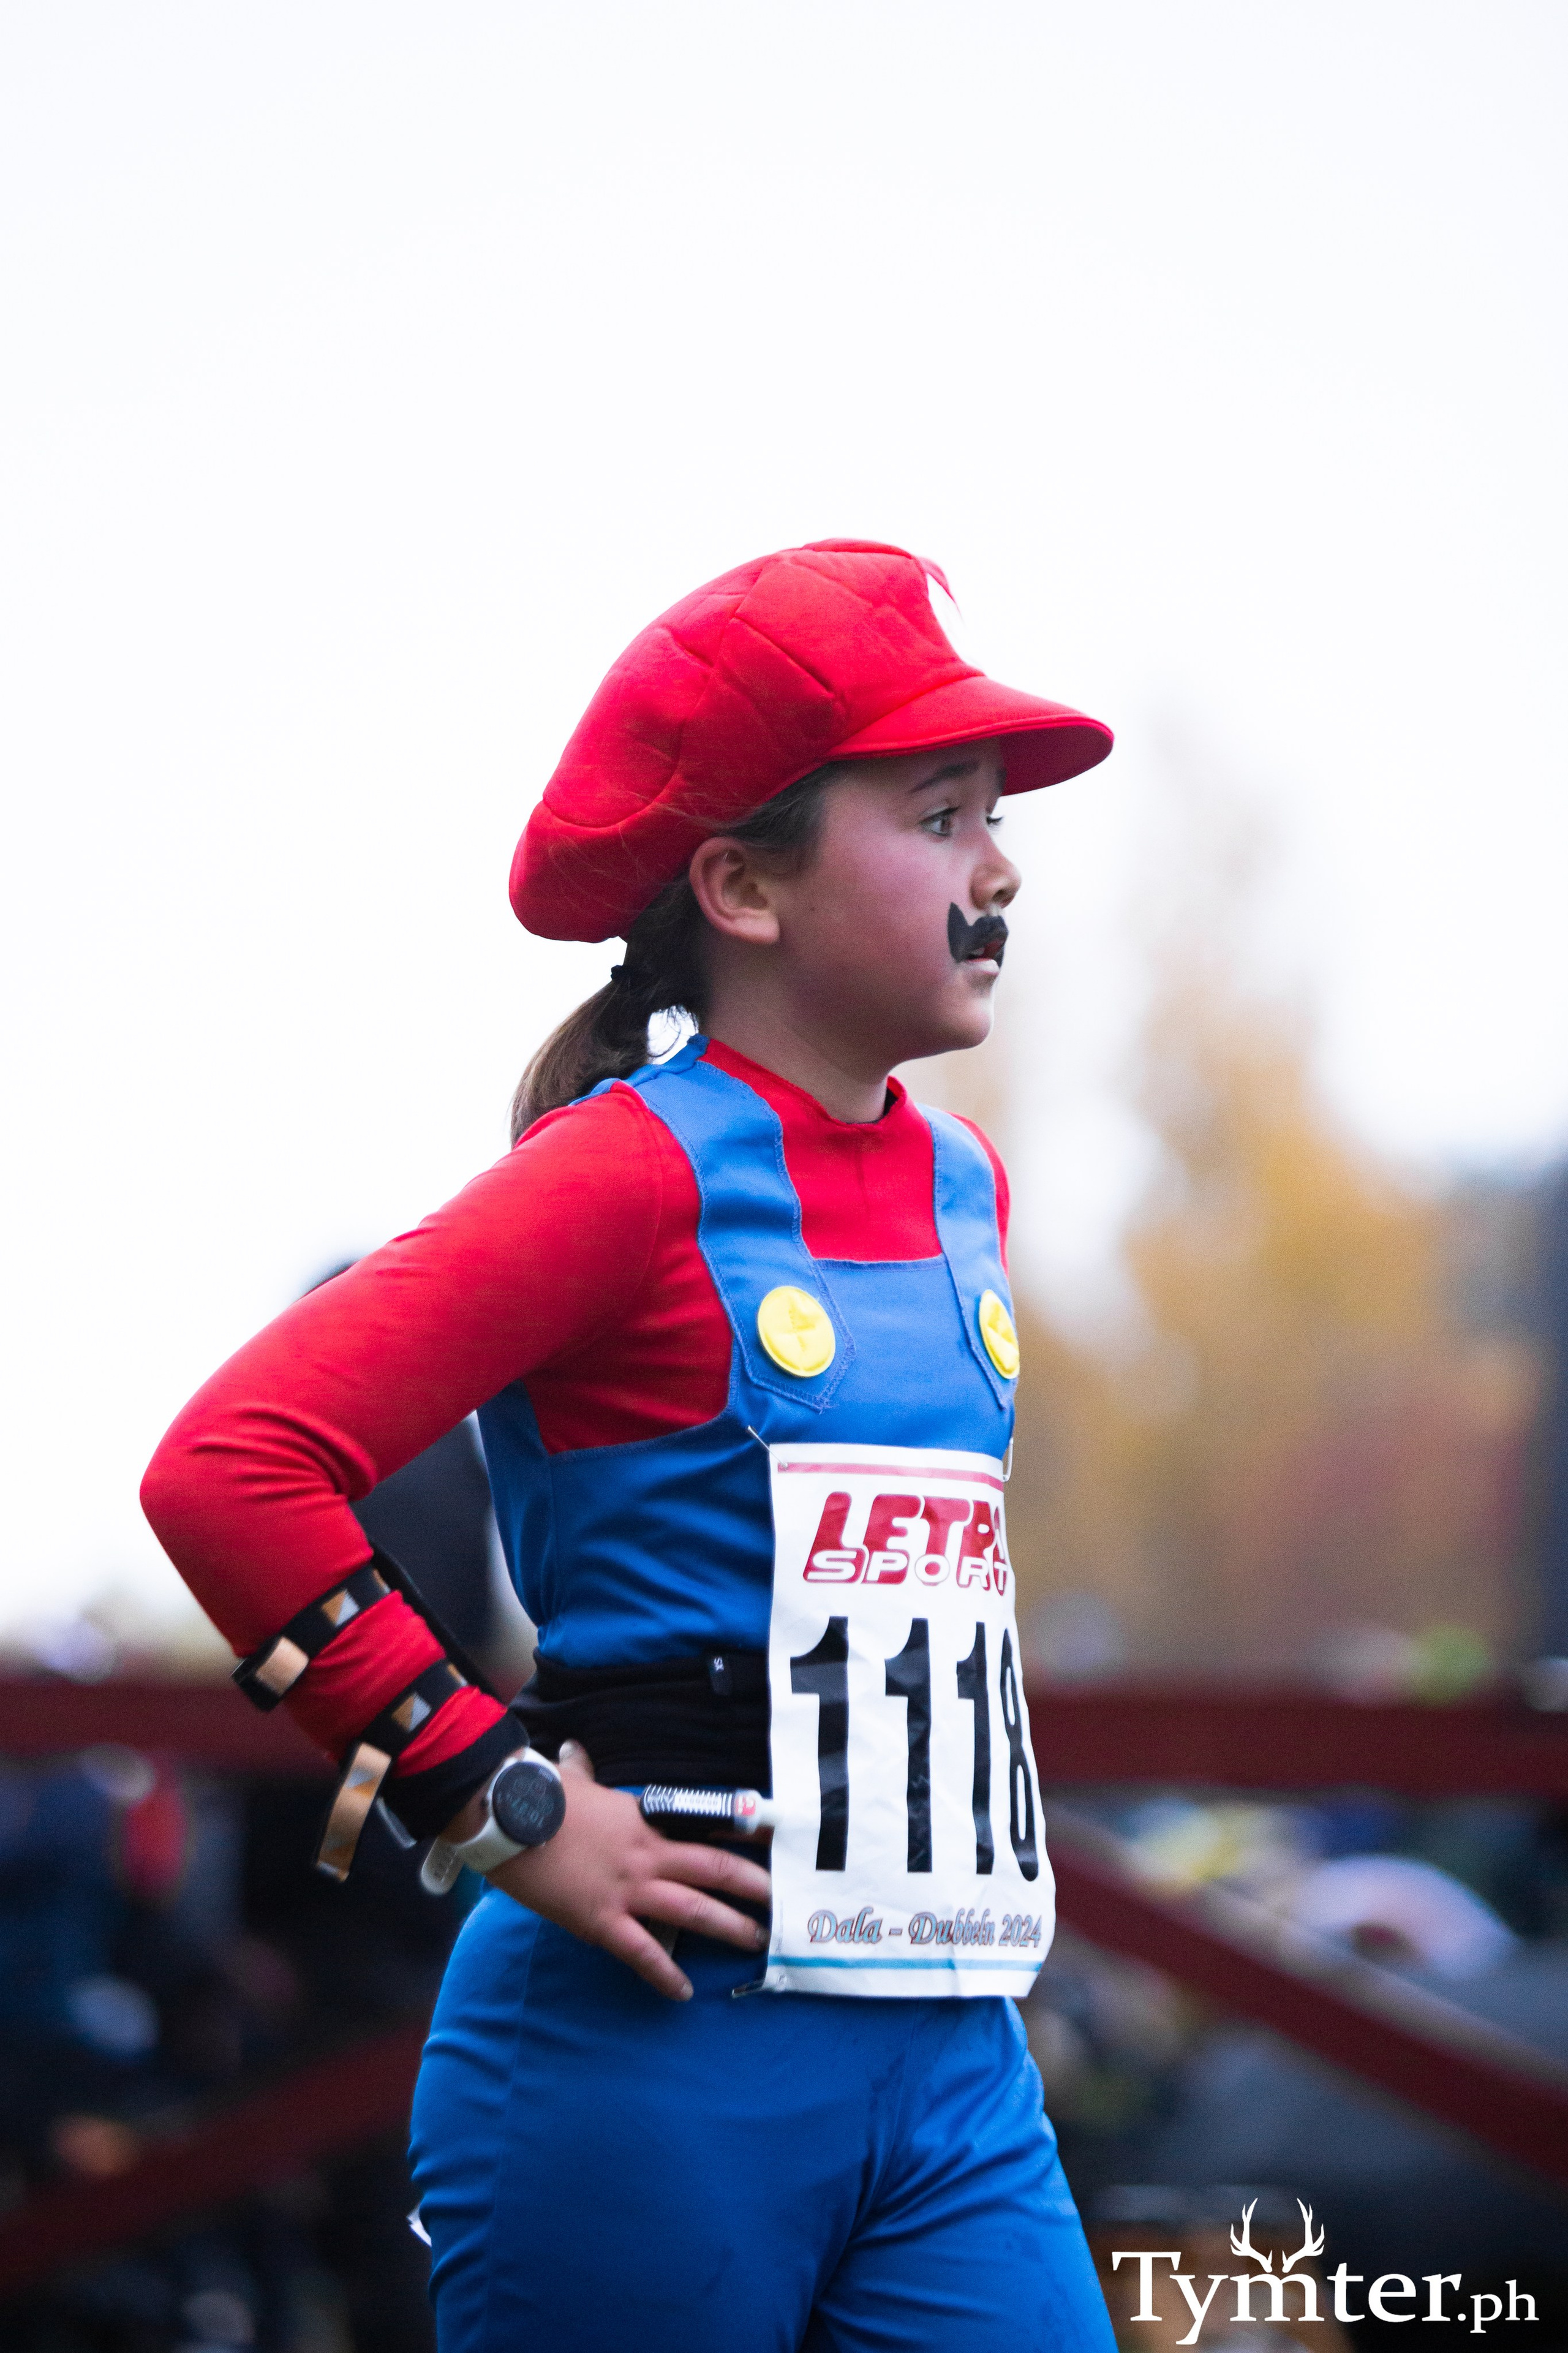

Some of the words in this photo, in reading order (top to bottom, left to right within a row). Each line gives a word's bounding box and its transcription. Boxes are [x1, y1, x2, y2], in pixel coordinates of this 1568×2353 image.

[807, 1549, 1008, 1592] SPORT
[790, 1615, 1039, 1882] 1118
[807, 1906, 883, 1944] Dala
[888, 1927, 903, 1936] -
[908, 1908, 995, 1946] Dubbeln
[998, 1914, 1042, 1948] 2024
